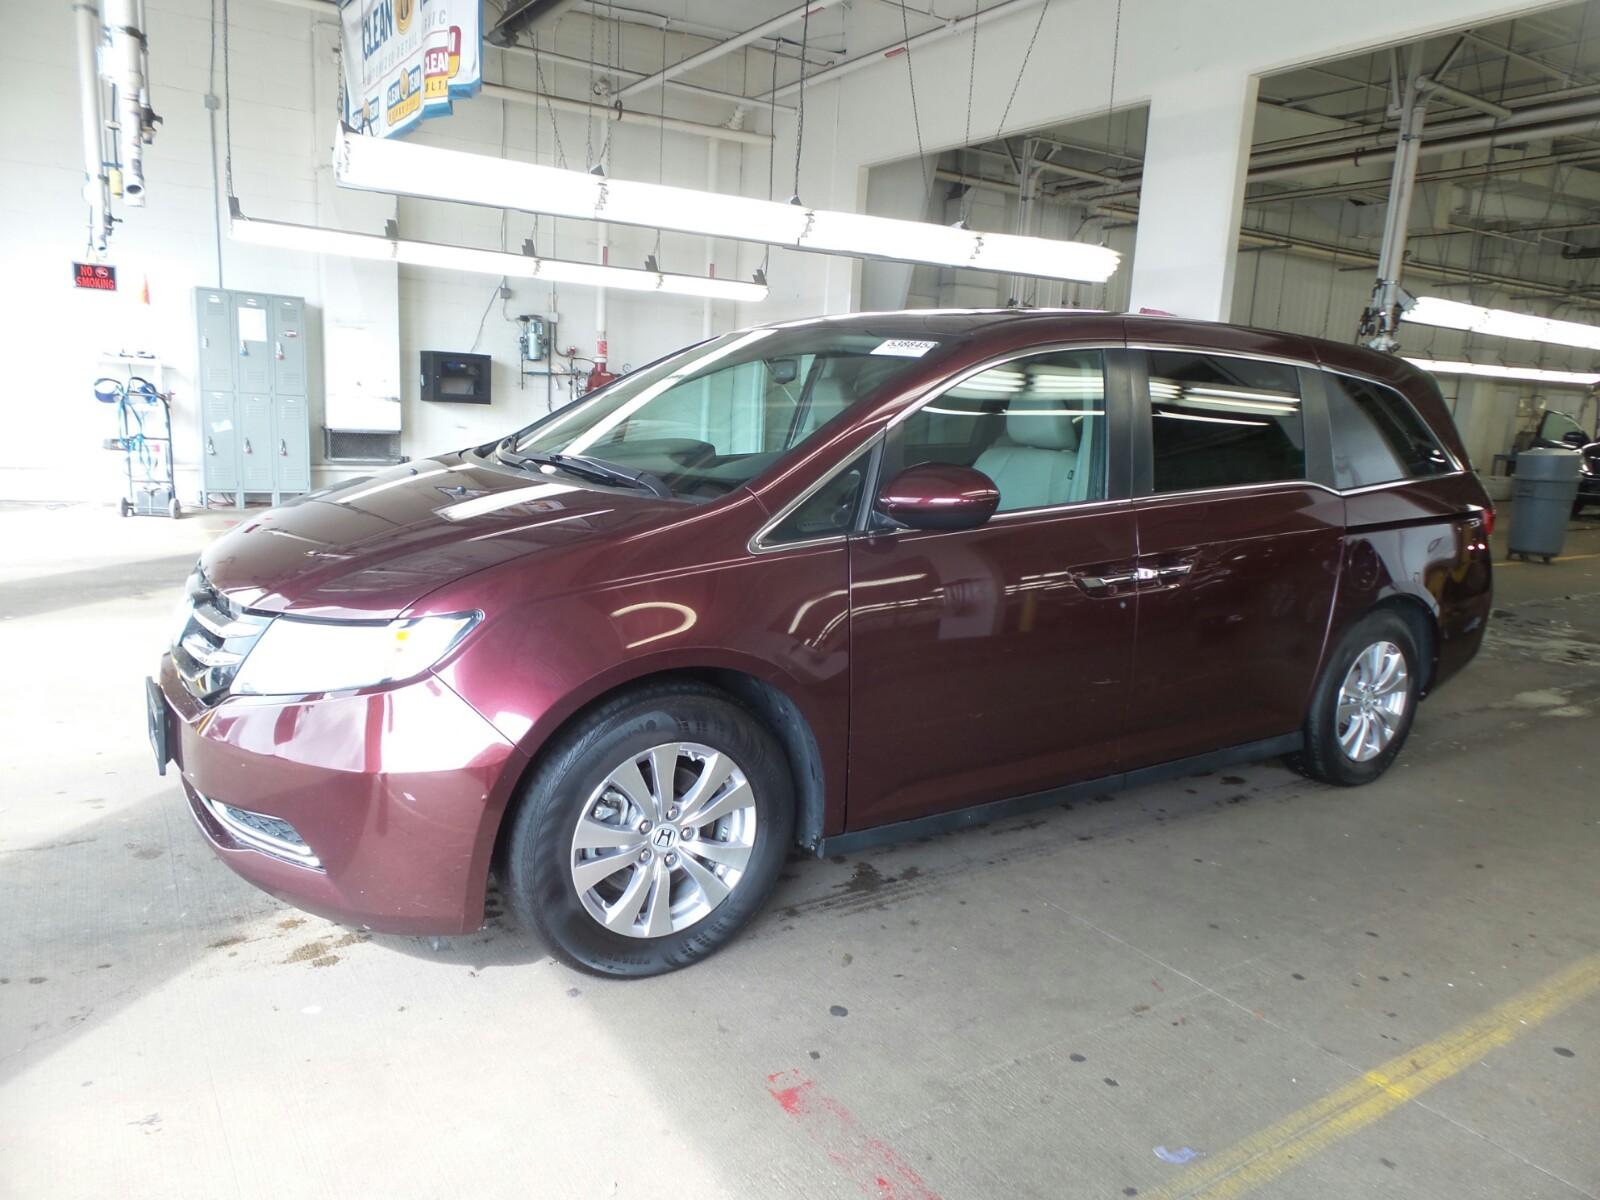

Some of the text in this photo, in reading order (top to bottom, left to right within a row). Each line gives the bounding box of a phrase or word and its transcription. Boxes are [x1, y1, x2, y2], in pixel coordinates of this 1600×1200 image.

[362, 0, 393, 61] CLEAN
[80, 265, 93, 277] NO
[76, 276, 115, 289] SMOKING
